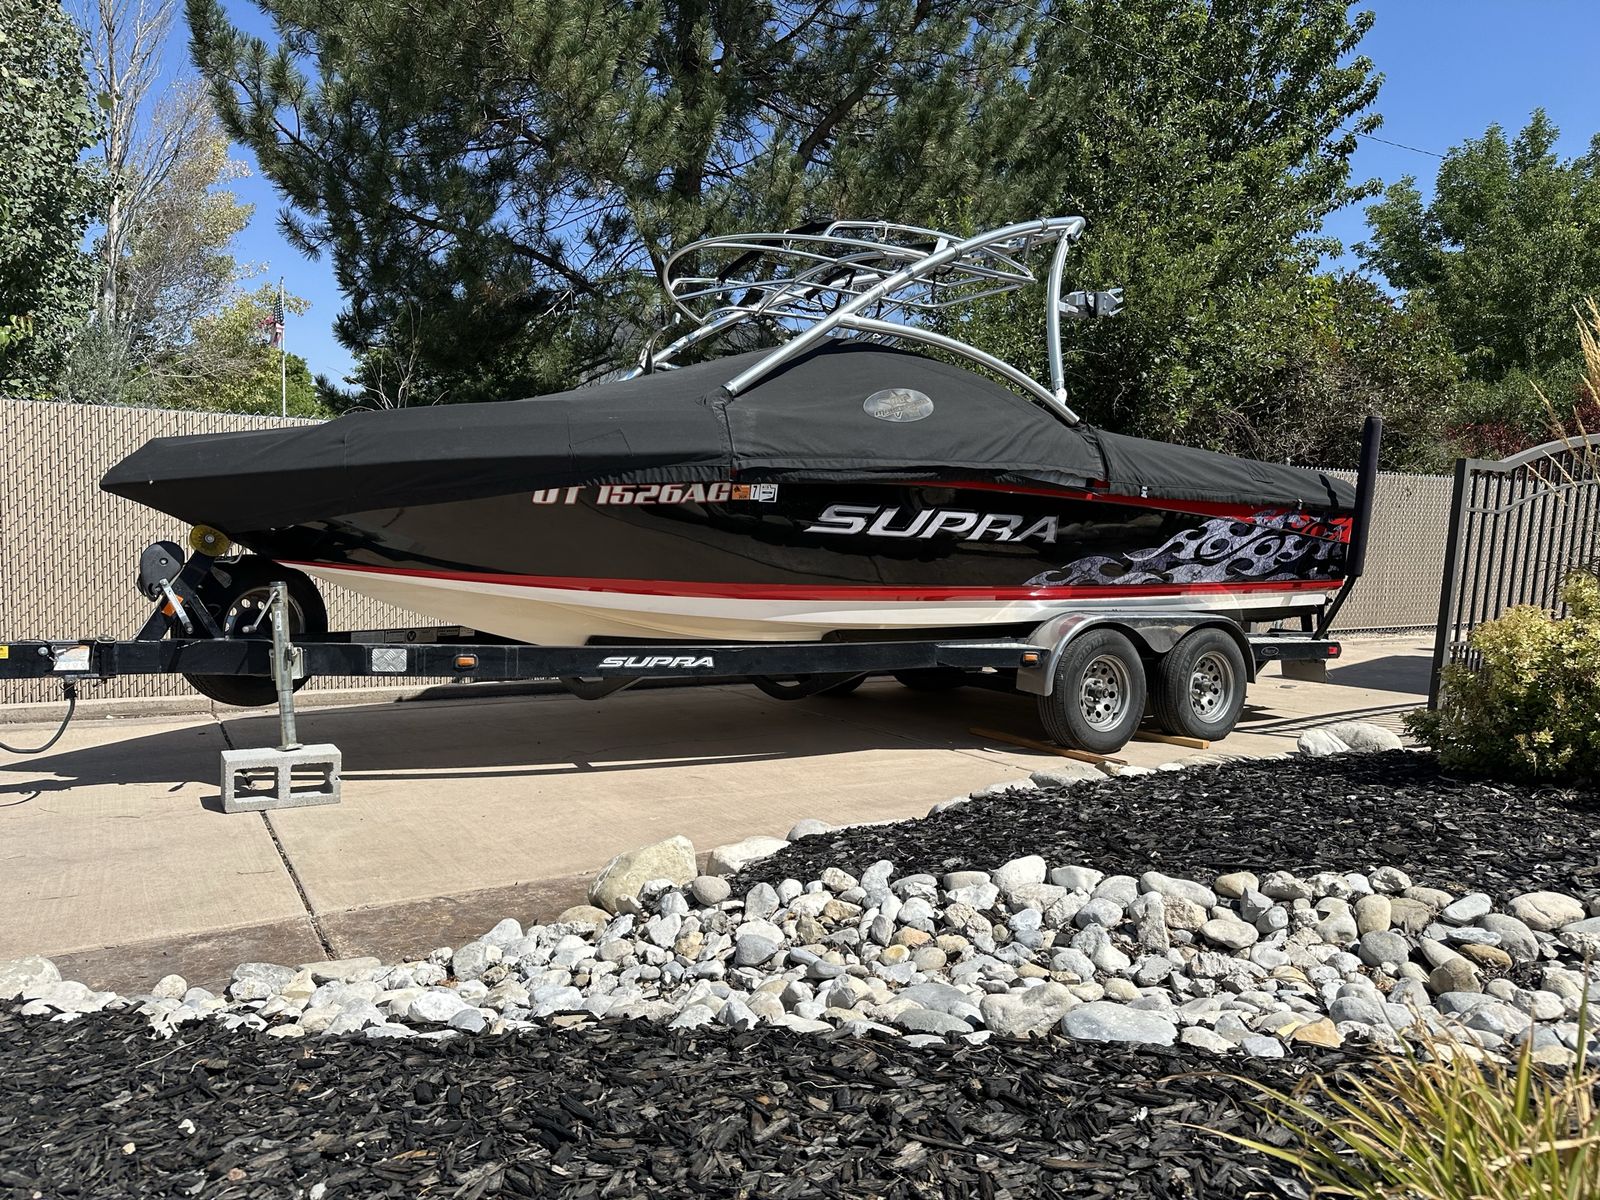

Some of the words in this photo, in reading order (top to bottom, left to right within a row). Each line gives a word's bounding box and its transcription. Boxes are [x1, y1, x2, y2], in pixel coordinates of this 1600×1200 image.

[532, 486, 586, 505] UT
[596, 482, 731, 505] 1526AG
[803, 504, 1060, 544] SUPRA
[597, 656, 714, 668] SUPRA
